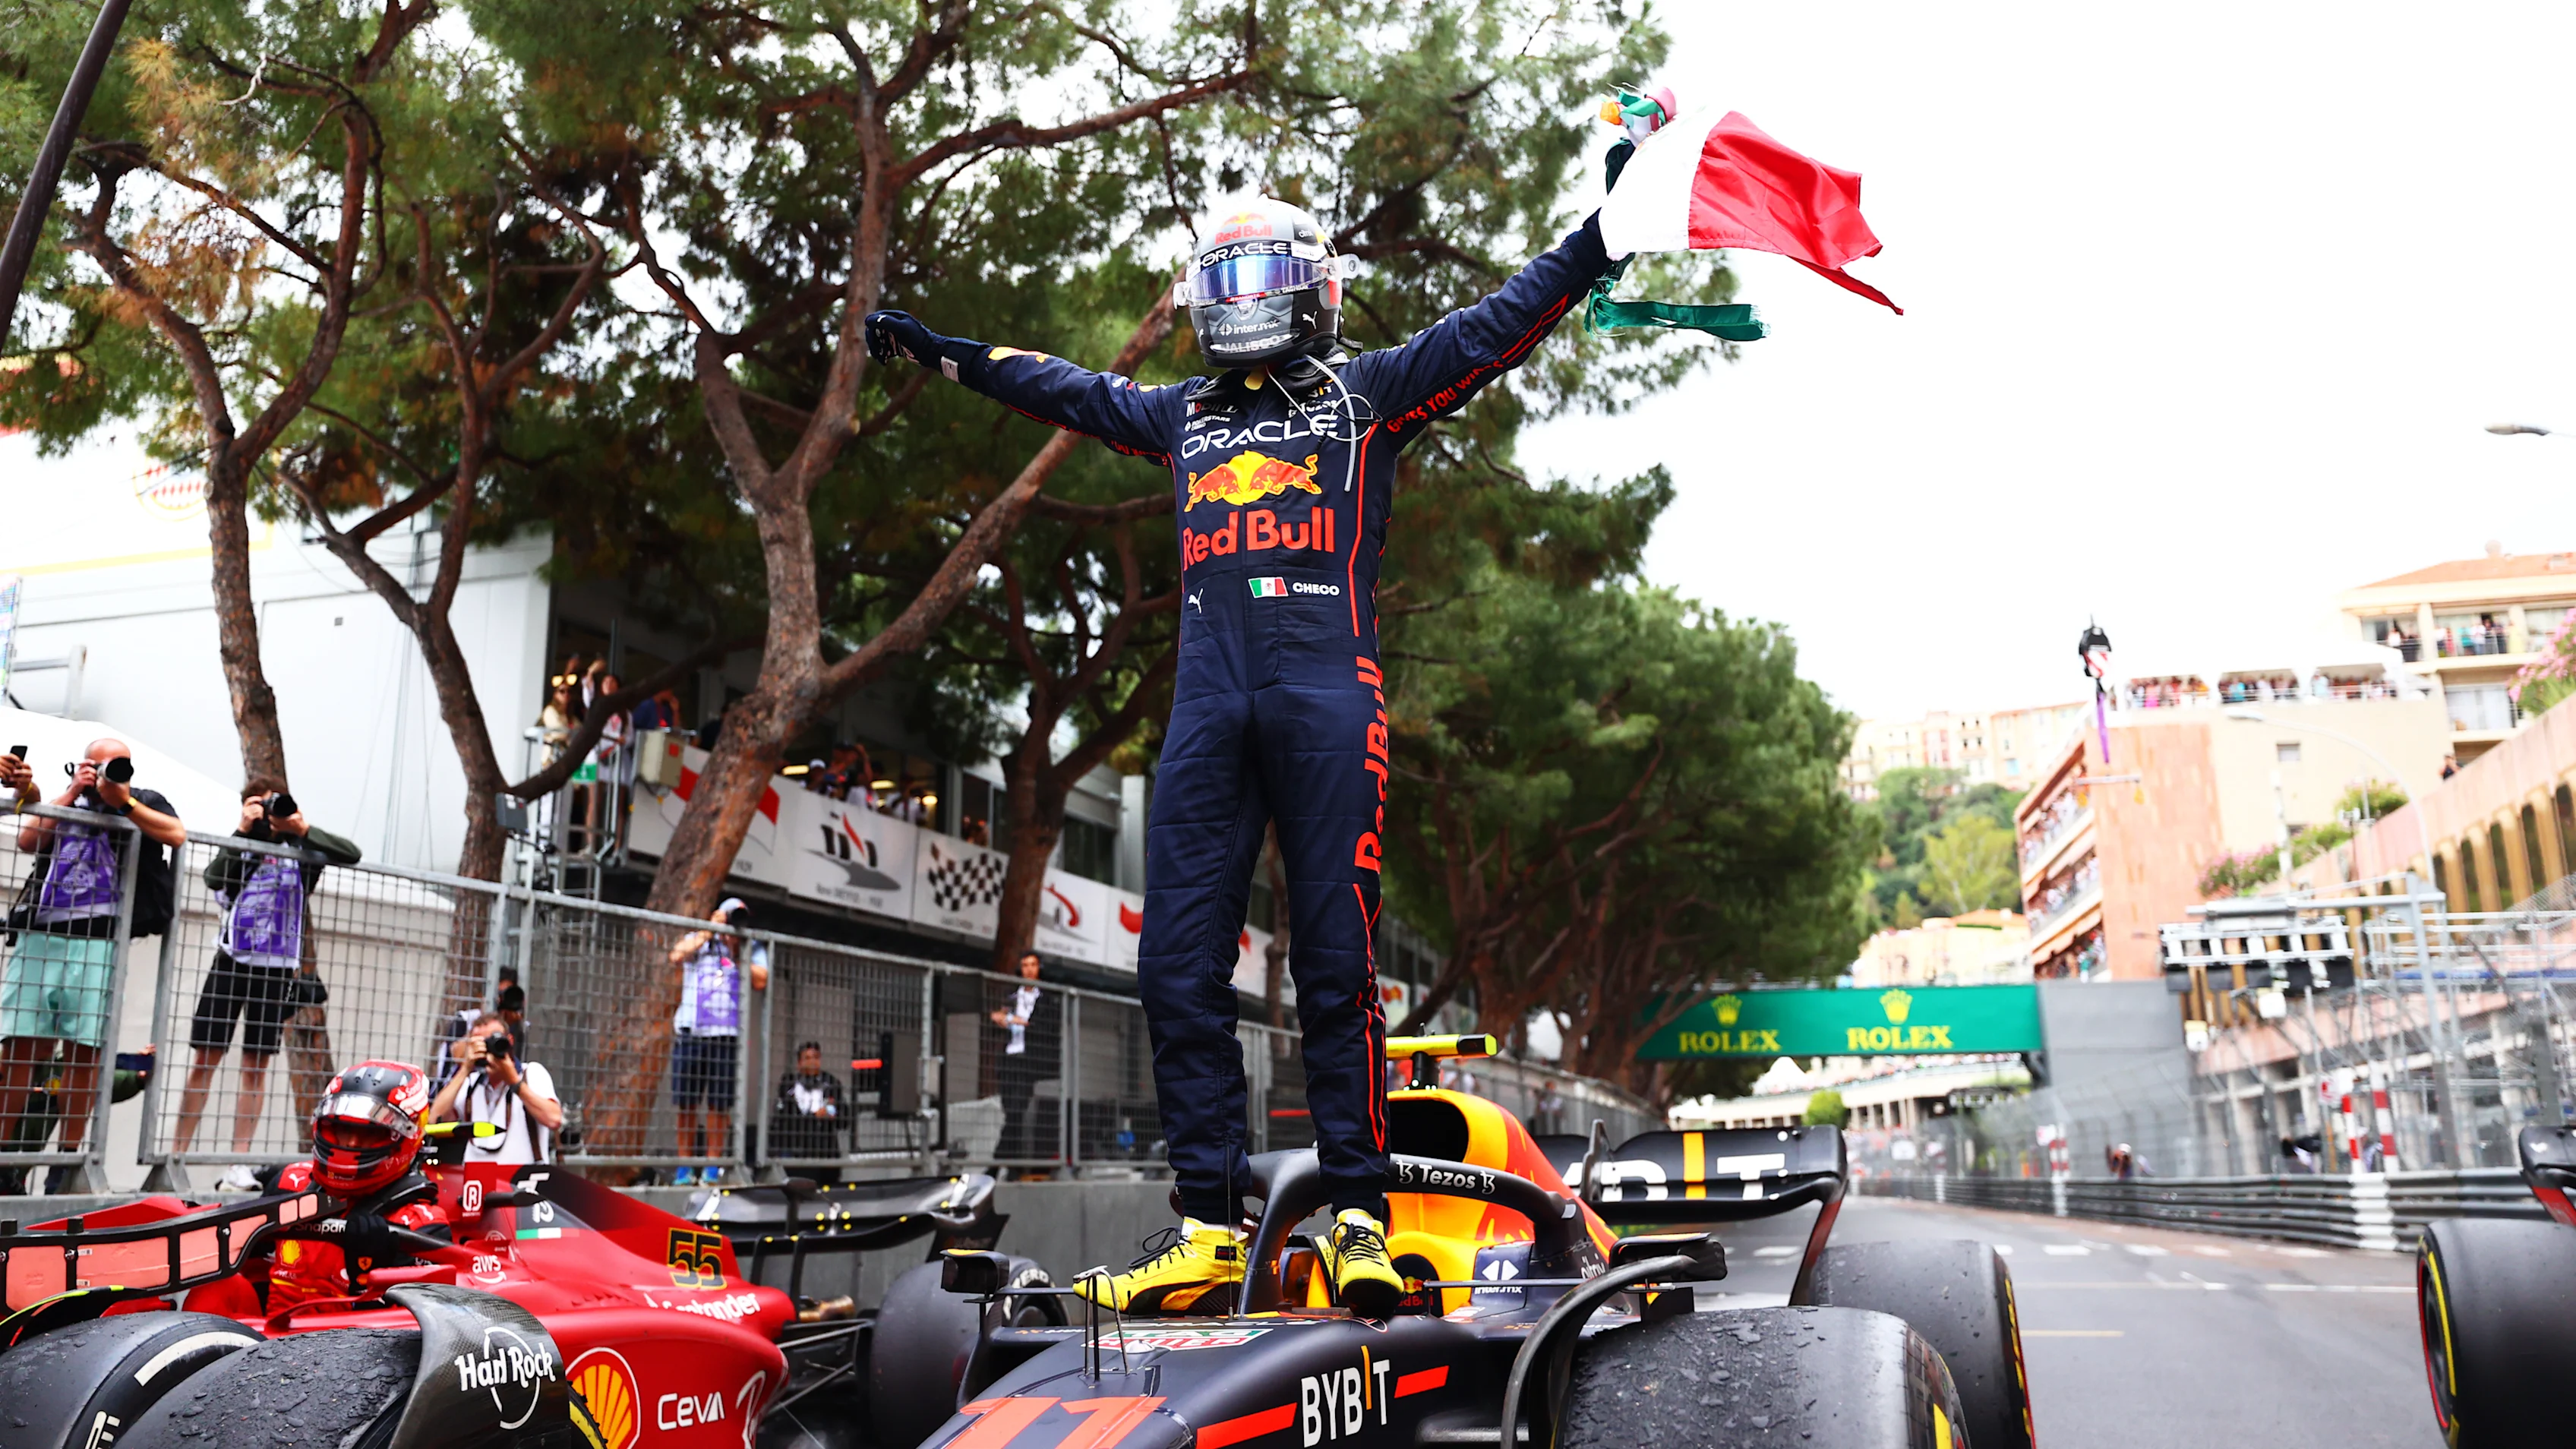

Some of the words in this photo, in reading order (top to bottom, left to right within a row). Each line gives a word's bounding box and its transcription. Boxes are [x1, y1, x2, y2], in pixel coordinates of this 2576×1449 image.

[1215, 226, 1242, 245] Red
[1243, 225, 1273, 237] Bull
[1202, 243, 1289, 267] ORACLE
[1233, 319, 1280, 335] inter.mx
[1425, 387, 1457, 412] YOU
[1181, 414, 1339, 459] ORACLE
[1182, 511, 1239, 571] Red
[1246, 506, 1335, 553] Bull
[1293, 582, 1340, 596] CHECO
[1678, 1029, 1782, 1053] ROLEX
[1846, 1025, 1953, 1050] ROLEX
[1419, 1164, 1476, 1189] Tezos
[472, 1255, 502, 1274] aws
[667, 1227, 728, 1290] 55
[1397, 1295, 1412, 1306] ed
[508, 1343, 556, 1388] Rock
[1301, 1345, 1390, 1448] BYBIT
[944, 1397, 1167, 1449] 11
